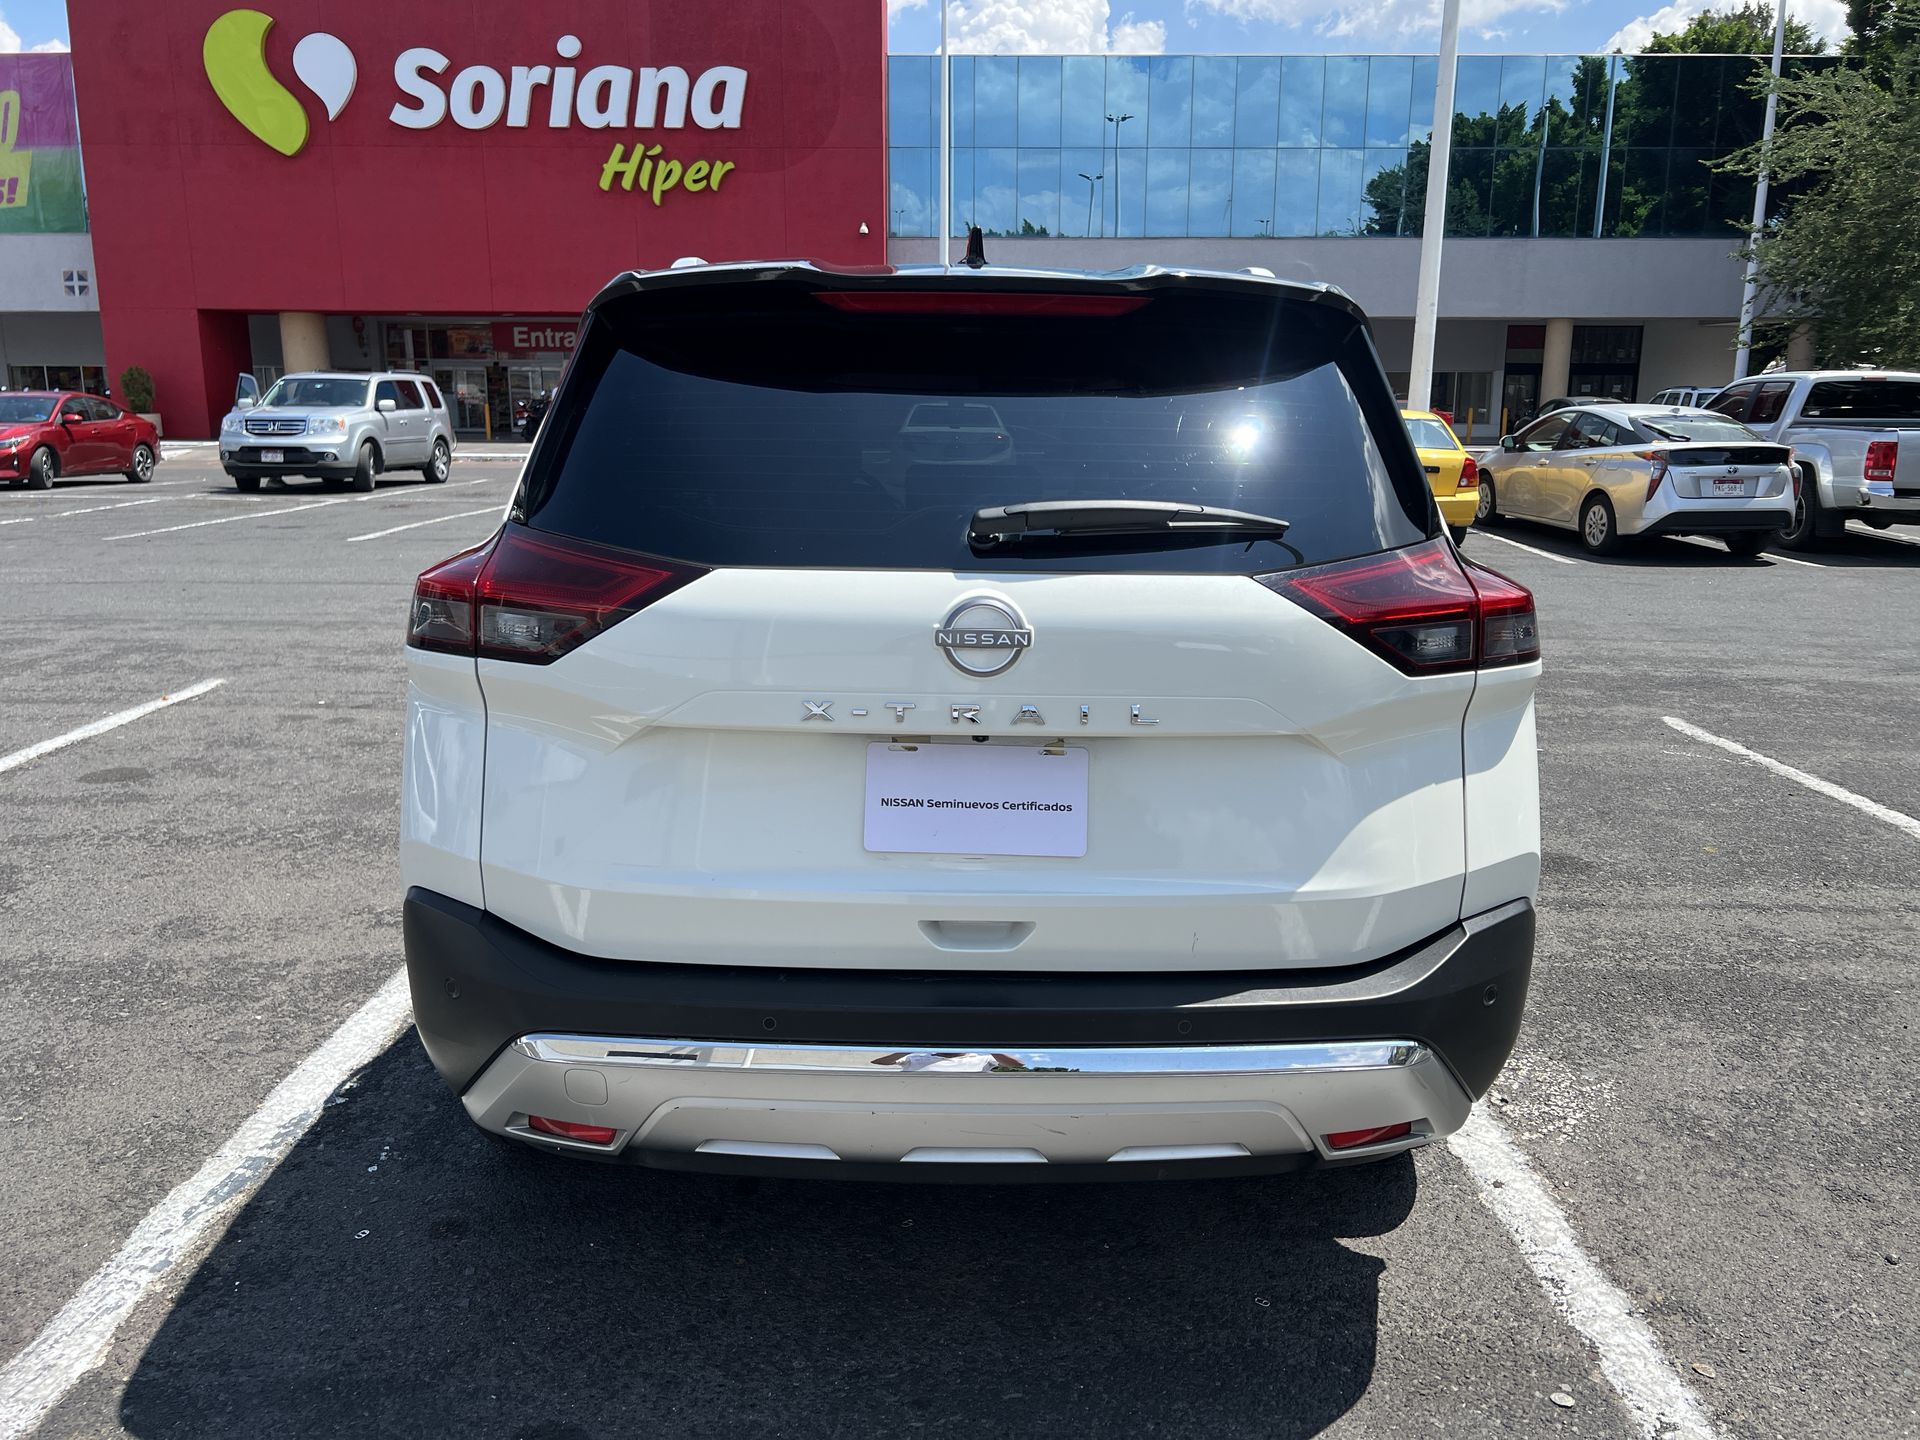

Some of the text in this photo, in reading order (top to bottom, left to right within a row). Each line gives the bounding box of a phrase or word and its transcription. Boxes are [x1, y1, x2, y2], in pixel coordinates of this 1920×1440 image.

[389, 34, 748, 129] Soriana
[599, 143, 735, 206] Híper
[938, 631, 1030, 647] NISSAN
[801, 700, 1160, 726] X-TRAIL
[880, 797, 1073, 812] NISSAN Seminuevos Certificados
